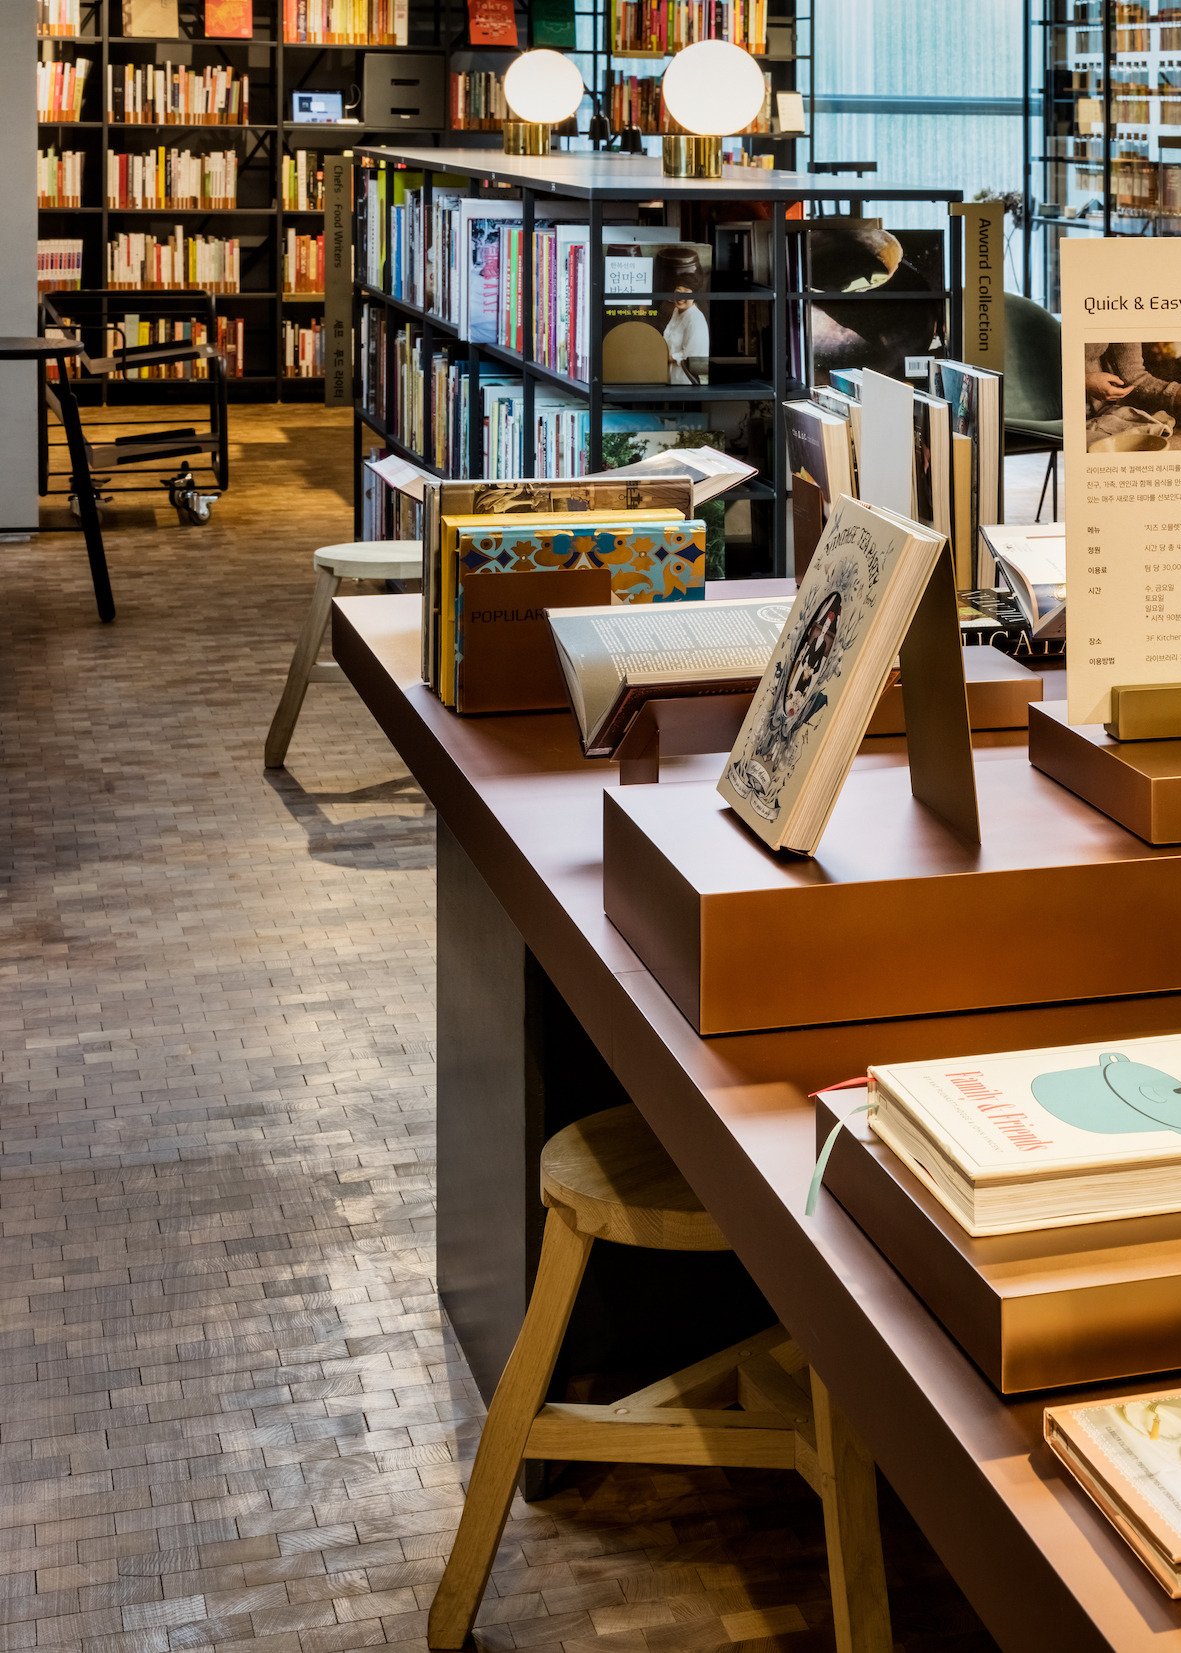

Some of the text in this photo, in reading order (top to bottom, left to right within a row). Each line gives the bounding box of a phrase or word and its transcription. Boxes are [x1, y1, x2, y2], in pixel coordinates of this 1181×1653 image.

[334, 165, 343, 269] Chefs Food Writers
[609, 272, 647, 285] 엄마의
[978, 218, 992, 352] Award Collection
[1084, 295, 1129, 315] Quick
[1134, 296, 1145, 311] &
[333, 369, 344, 398] 라이터
[1086, 466, 1118, 474] 라이브러리
[1087, 526, 1100, 534] 메뉴
[1088, 546, 1101, 554] 정원
[1144, 544, 1158, 552] 시간
[1088, 566, 1108, 575] 이용료
[1088, 587, 1102, 595] 시간
[1155, 583, 1175, 592] 금요일
[1145, 594, 1164, 602] 토요일
[1145, 604, 1164, 613] 일요일
[471, 608, 545, 624] POPULAR
[1088, 637, 1102, 646] 장소
[1089, 657, 1115, 666] 이용방법
[1145, 654, 1178, 662] 라이브러리
[944, 1071, 1054, 1152] Family & Friends
